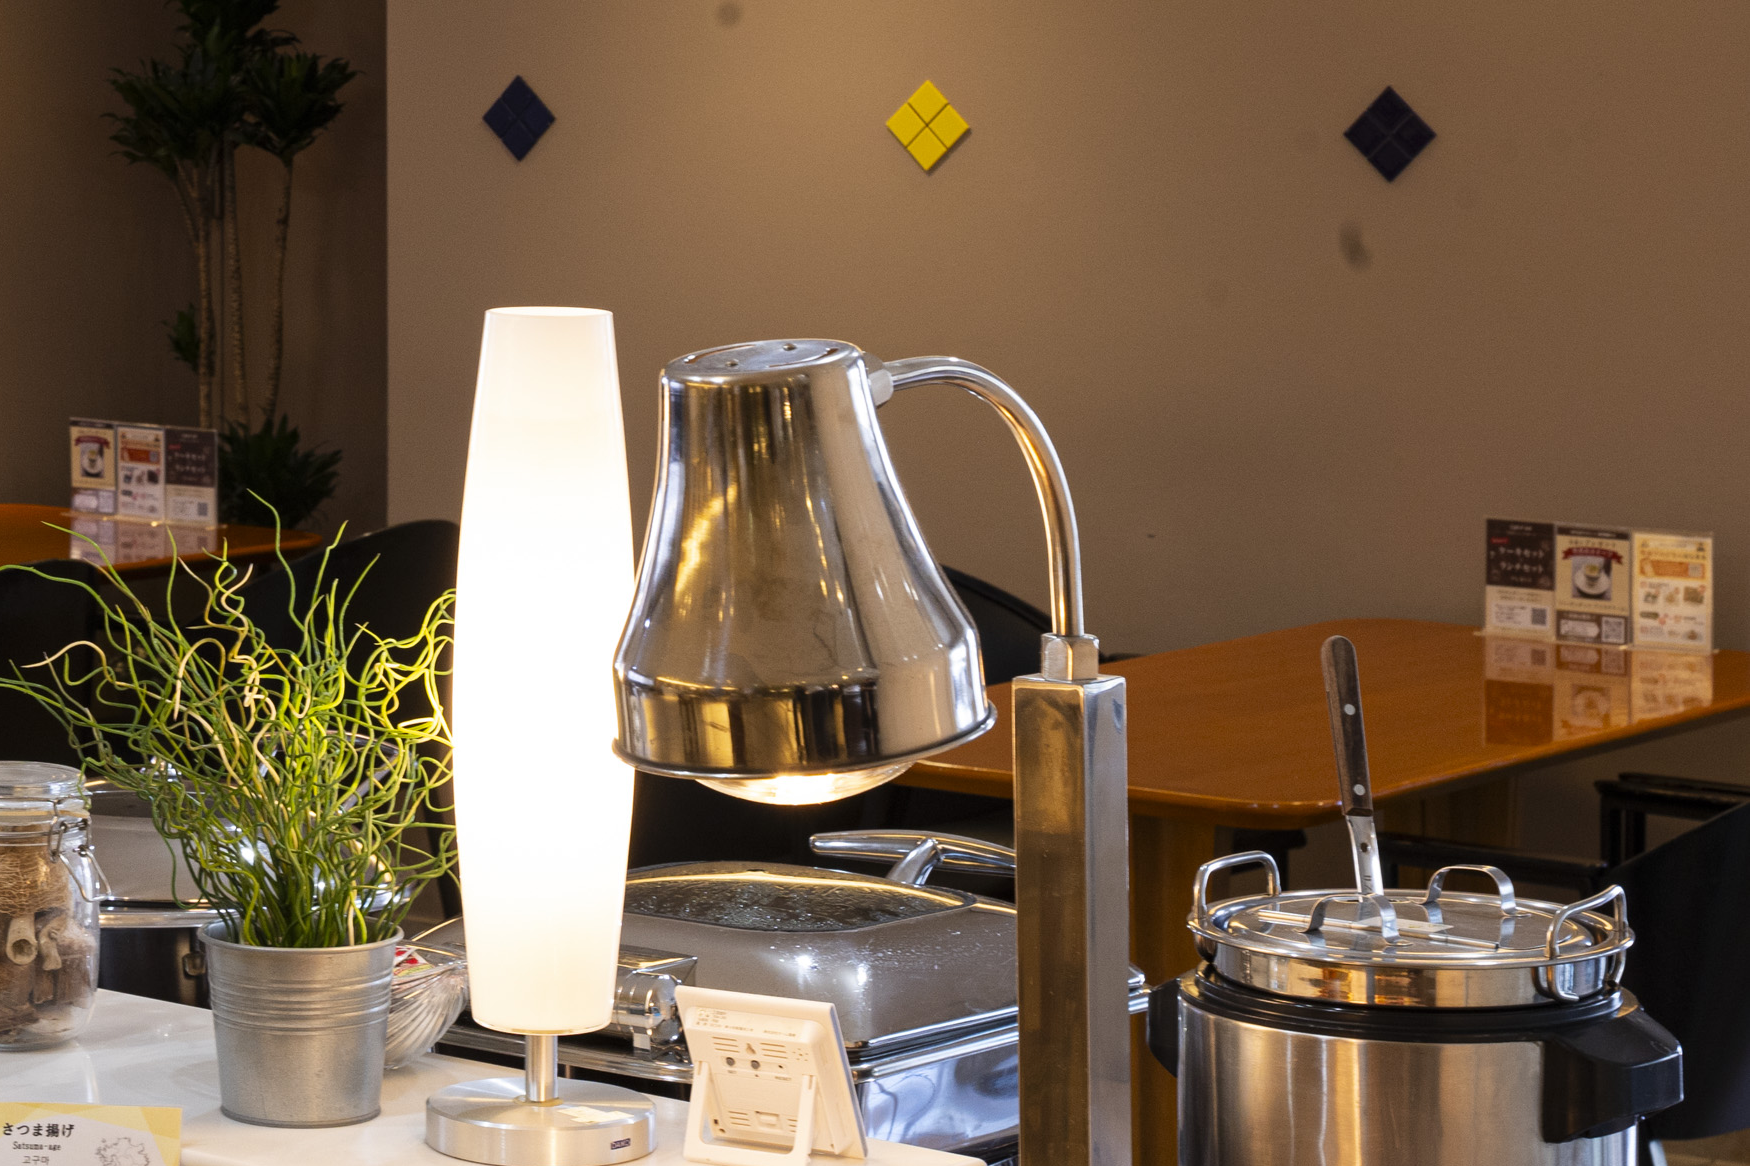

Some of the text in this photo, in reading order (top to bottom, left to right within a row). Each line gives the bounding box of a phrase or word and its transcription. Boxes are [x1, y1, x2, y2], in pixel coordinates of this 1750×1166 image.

[2, 1122, 75, 1138] さつま揚げ
[22, 1155, 50, 1165] 고구마
